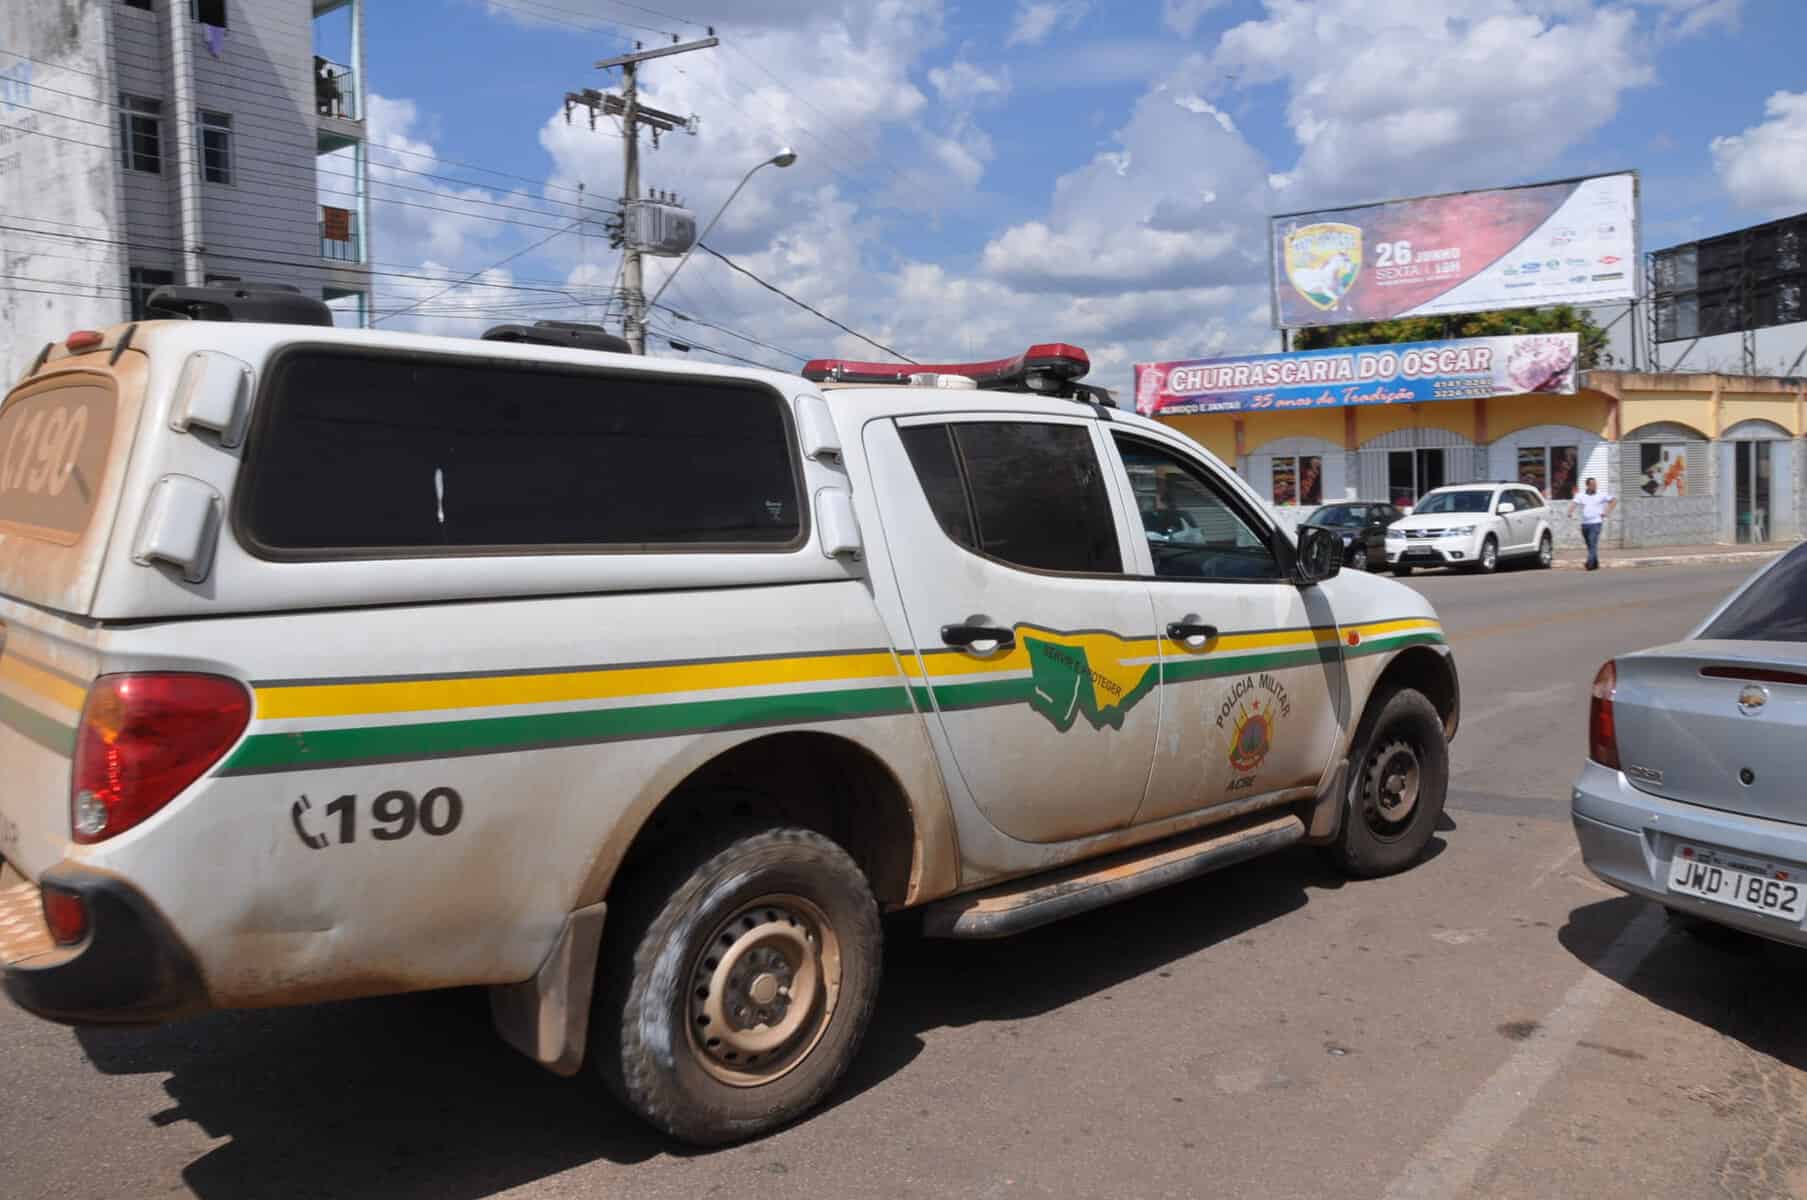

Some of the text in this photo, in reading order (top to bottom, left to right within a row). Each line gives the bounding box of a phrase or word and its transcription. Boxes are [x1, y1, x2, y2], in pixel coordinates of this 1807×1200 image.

[1376, 240, 1413, 268] 26
[1376, 264, 1419, 282] SEXTA
[1170, 348, 1492, 392] CHURRASCARIA DO OSCAR
[1251, 394, 1275, 409] 35
[1276, 396, 1313, 408] anos
[1342, 386, 1416, 404] Tradição
[13, 405, 88, 496] 190
[1259, 673, 1290, 718] MILITAR
[326, 786, 463, 844] 190
